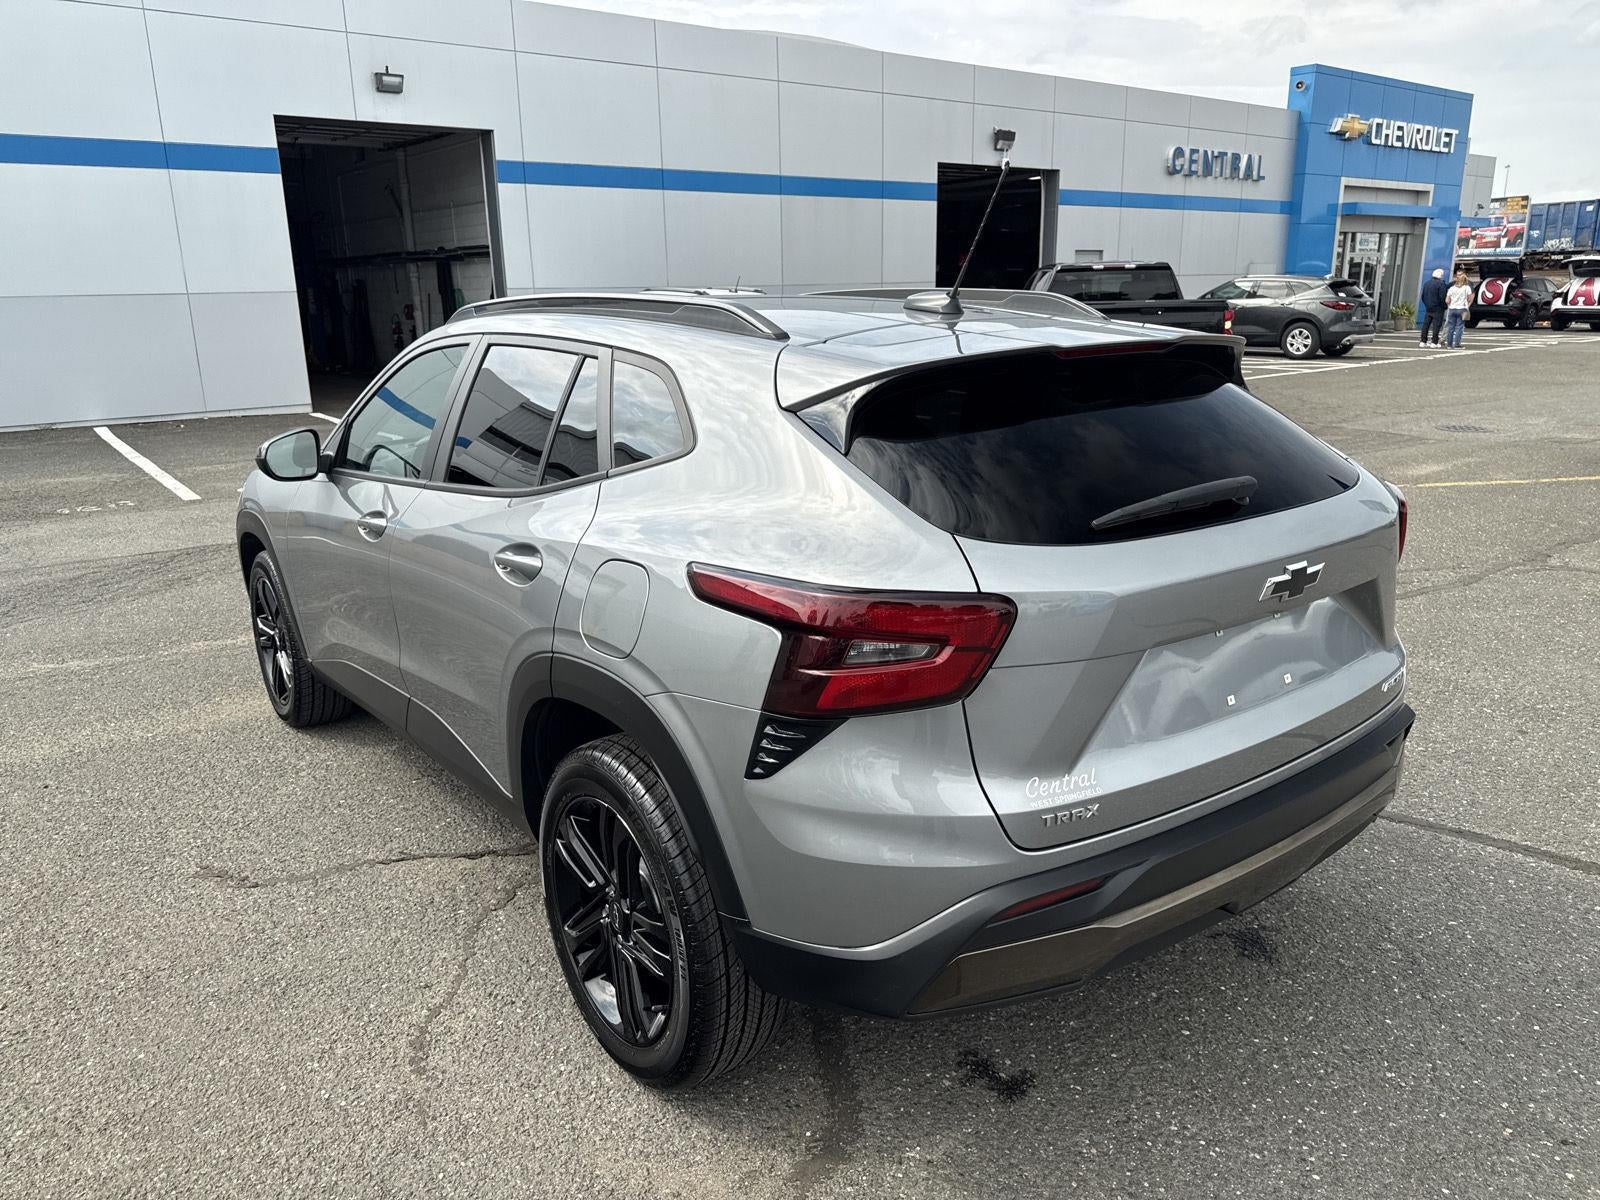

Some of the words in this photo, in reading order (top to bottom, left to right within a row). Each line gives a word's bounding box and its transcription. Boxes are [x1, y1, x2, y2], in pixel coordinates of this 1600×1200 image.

[1371, 118, 1459, 153] CHEVROLET
[1168, 146, 1265, 180] CENTRAL
[1481, 277, 1509, 305] S
[1569, 277, 1597, 306] A
[1025, 767, 1097, 798] Central
[1030, 800, 1053, 809] WEST
[1056, 787, 1103, 804] SPRINGFIELD
[1041, 804, 1100, 827] TRAX
